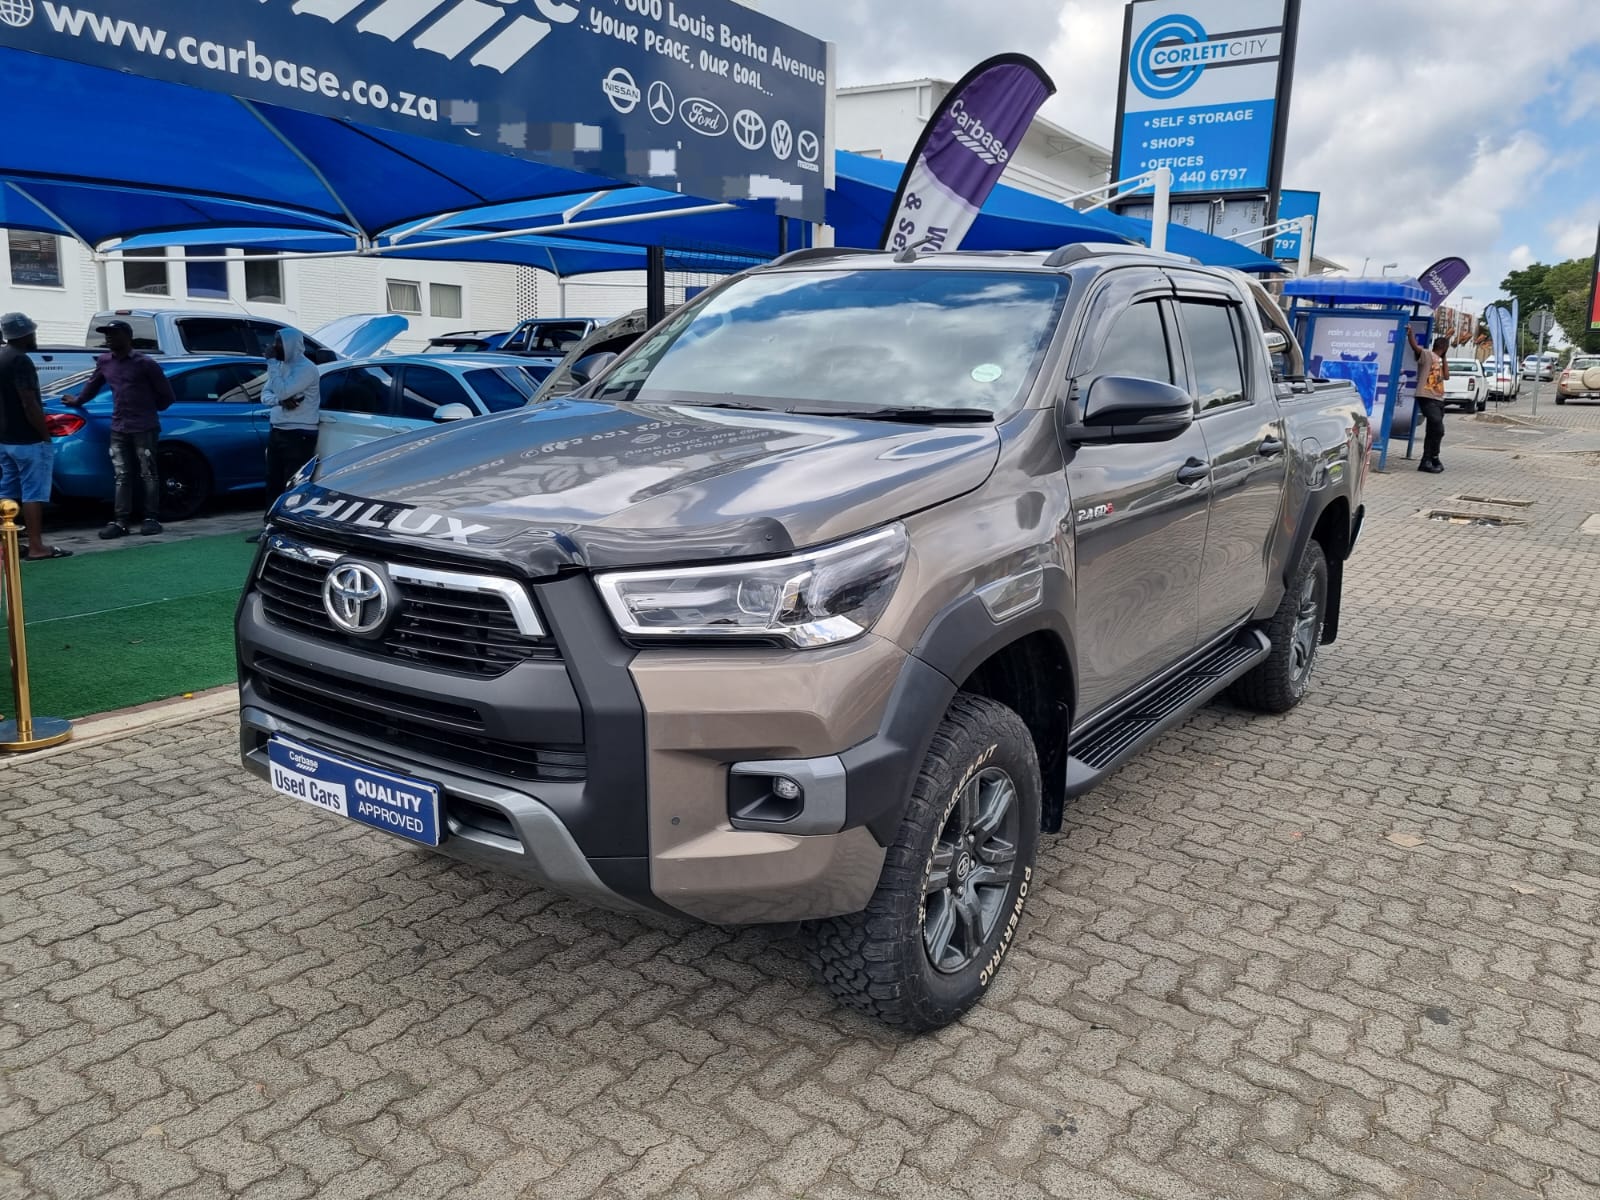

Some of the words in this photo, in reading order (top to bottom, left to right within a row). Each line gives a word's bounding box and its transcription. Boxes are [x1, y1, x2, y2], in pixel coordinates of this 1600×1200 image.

[669, 2, 715, 43] Louis
[720, 23, 767, 63] Botha
[771, 46, 826, 86] Avenue
[42, 1, 438, 121] www.carbase.co.za
[644, 29, 694, 69] PEACE,
[699, 49, 729, 78] OUR
[733, 62, 774, 97] GOAL...
[604, 81, 639, 100] NISSAN
[688, 101, 720, 131] Ford
[950, 98, 1009, 164] Carbase
[1151, 115, 1185, 129] SELF
[1188, 109, 1254, 126] STORAGE
[1149, 135, 1195, 150] SHOPS
[1147, 155, 1205, 170] OFFICES
[1179, 170, 1206, 183] 440
[1210, 167, 1248, 182] 6797
[904, 192, 922, 211] &
[1275, 238, 1297, 249] 797
[290, 497, 491, 545] HILUX
[289, 751, 319, 768] Carbase
[274, 768, 306, 798] Used
[310, 781, 341, 810] Cars
[354, 778, 422, 813] QUALITY
[358, 801, 424, 833] APPROVED
[979, 865, 1031, 987] POWERTRAC
